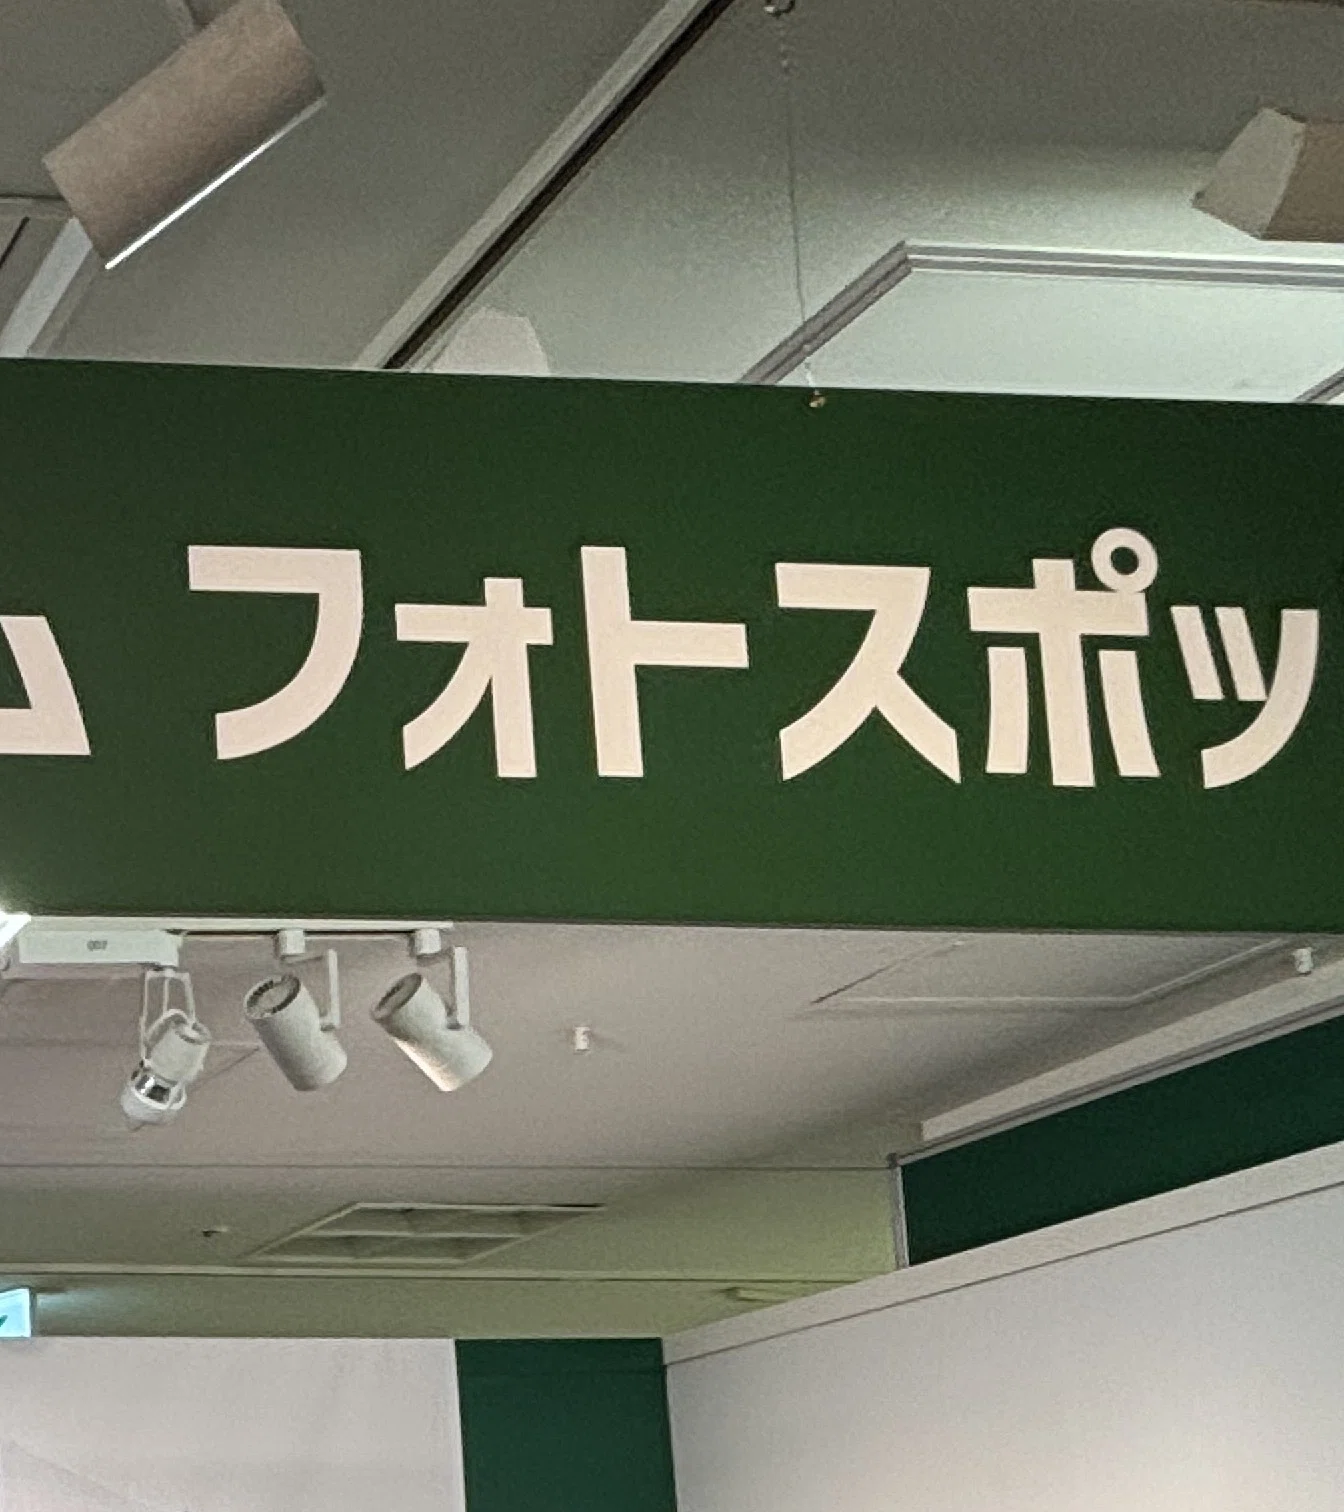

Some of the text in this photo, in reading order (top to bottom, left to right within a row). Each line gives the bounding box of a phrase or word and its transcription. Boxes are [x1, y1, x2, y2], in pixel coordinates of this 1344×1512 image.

[187, 526, 1318, 788] フォトスポッ
